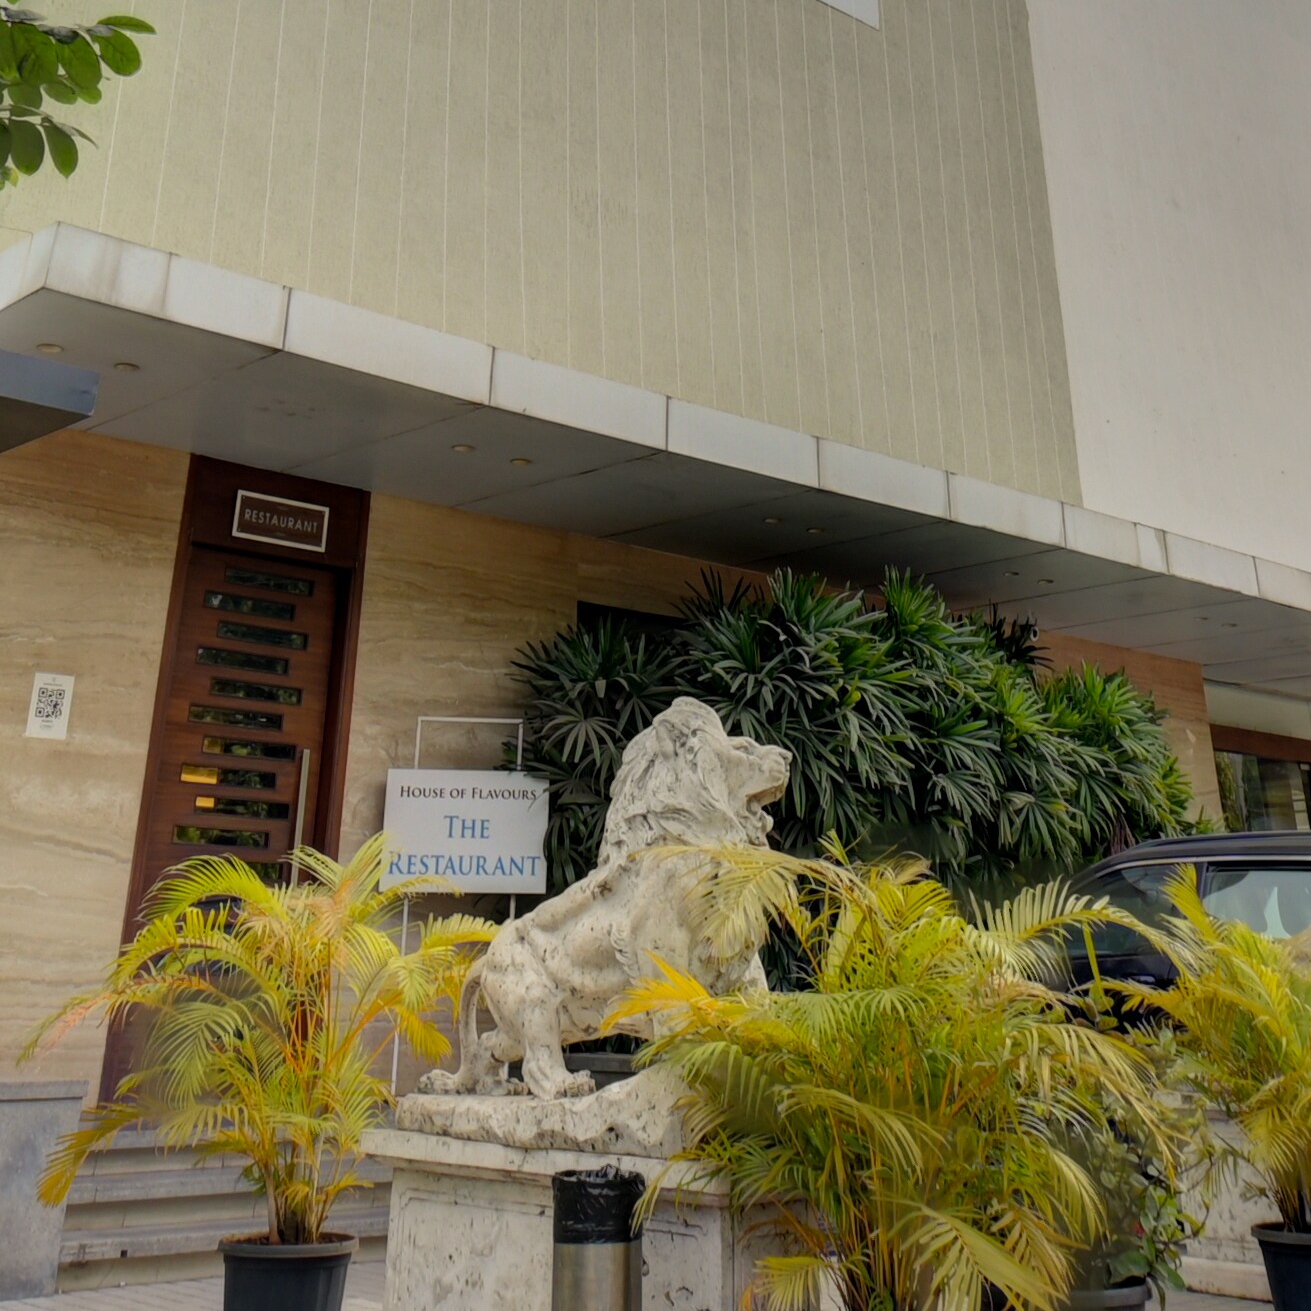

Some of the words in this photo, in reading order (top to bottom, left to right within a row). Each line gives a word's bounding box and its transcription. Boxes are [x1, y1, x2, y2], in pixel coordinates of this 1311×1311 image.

[243, 507, 319, 535] RESTAURANT
[400, 785, 445, 799] HOUSE
[449, 787, 467, 799] OF
[471, 786, 537, 801] FLAVOURS
[444, 815, 491, 839] THE
[388, 850, 541, 877] RESTAURANT
